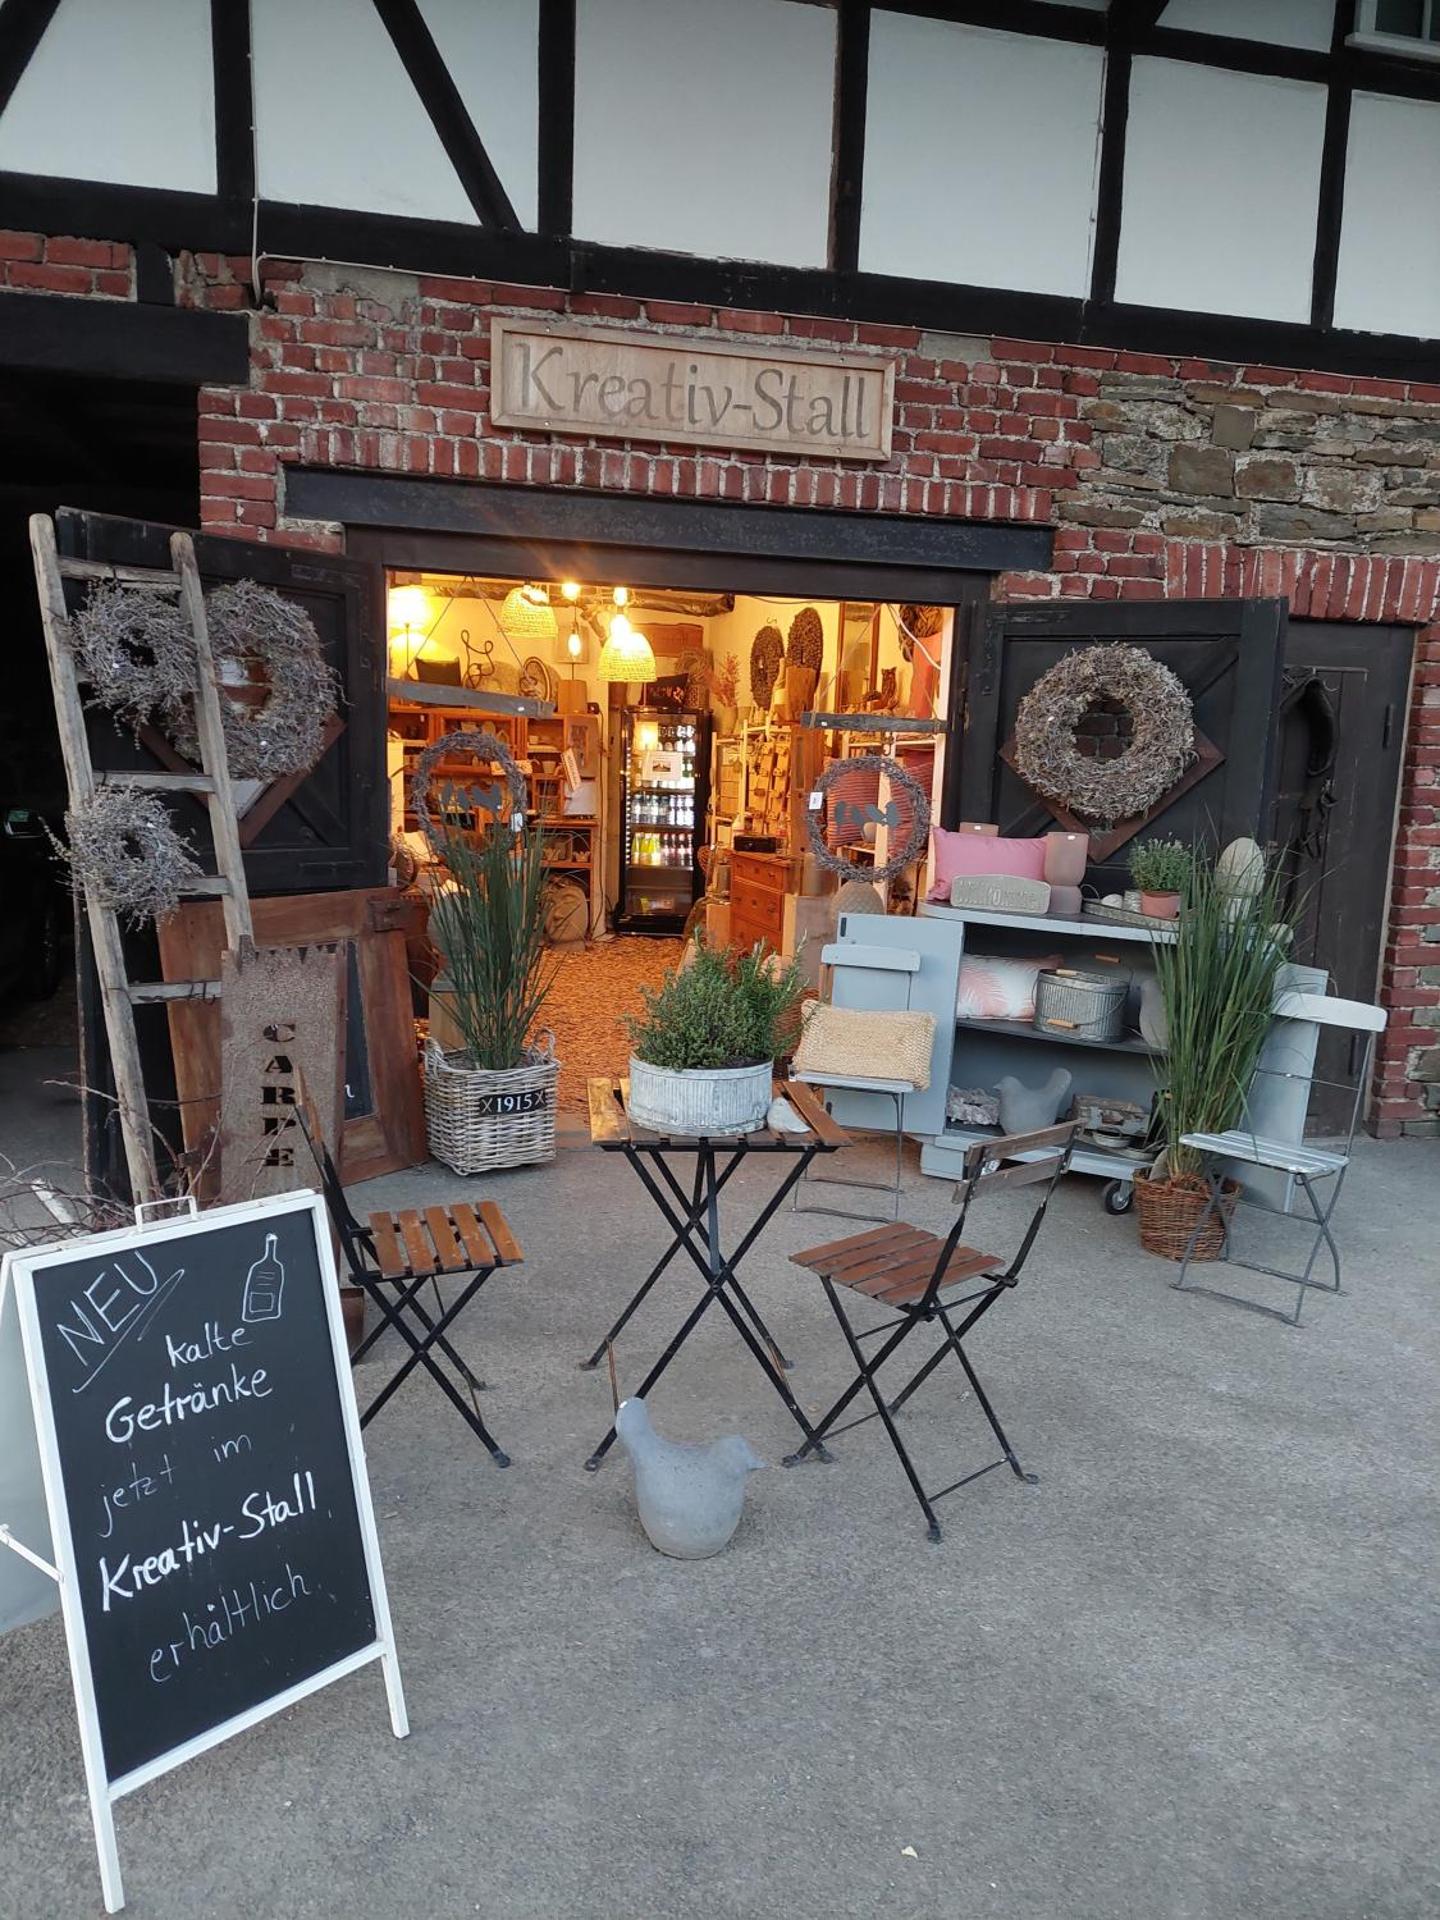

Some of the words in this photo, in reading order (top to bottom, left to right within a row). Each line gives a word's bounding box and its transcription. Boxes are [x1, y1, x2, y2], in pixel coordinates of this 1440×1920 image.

[511, 342, 869, 438] Kreativ-Stall
[260, 1023, 297, 1167] CARPE
[497, 1095, 533, 1113] 1915
[56, 1250, 161, 1366] NEU
[166, 1321, 254, 1368] kalte
[105, 1365, 273, 1443] Getränke
[101, 1454, 174, 1537] jetzt
[213, 1431, 253, 1463] im
[101, 1471, 317, 1611] Kreativ-Stall
[150, 1563, 311, 1682] erhältlich
